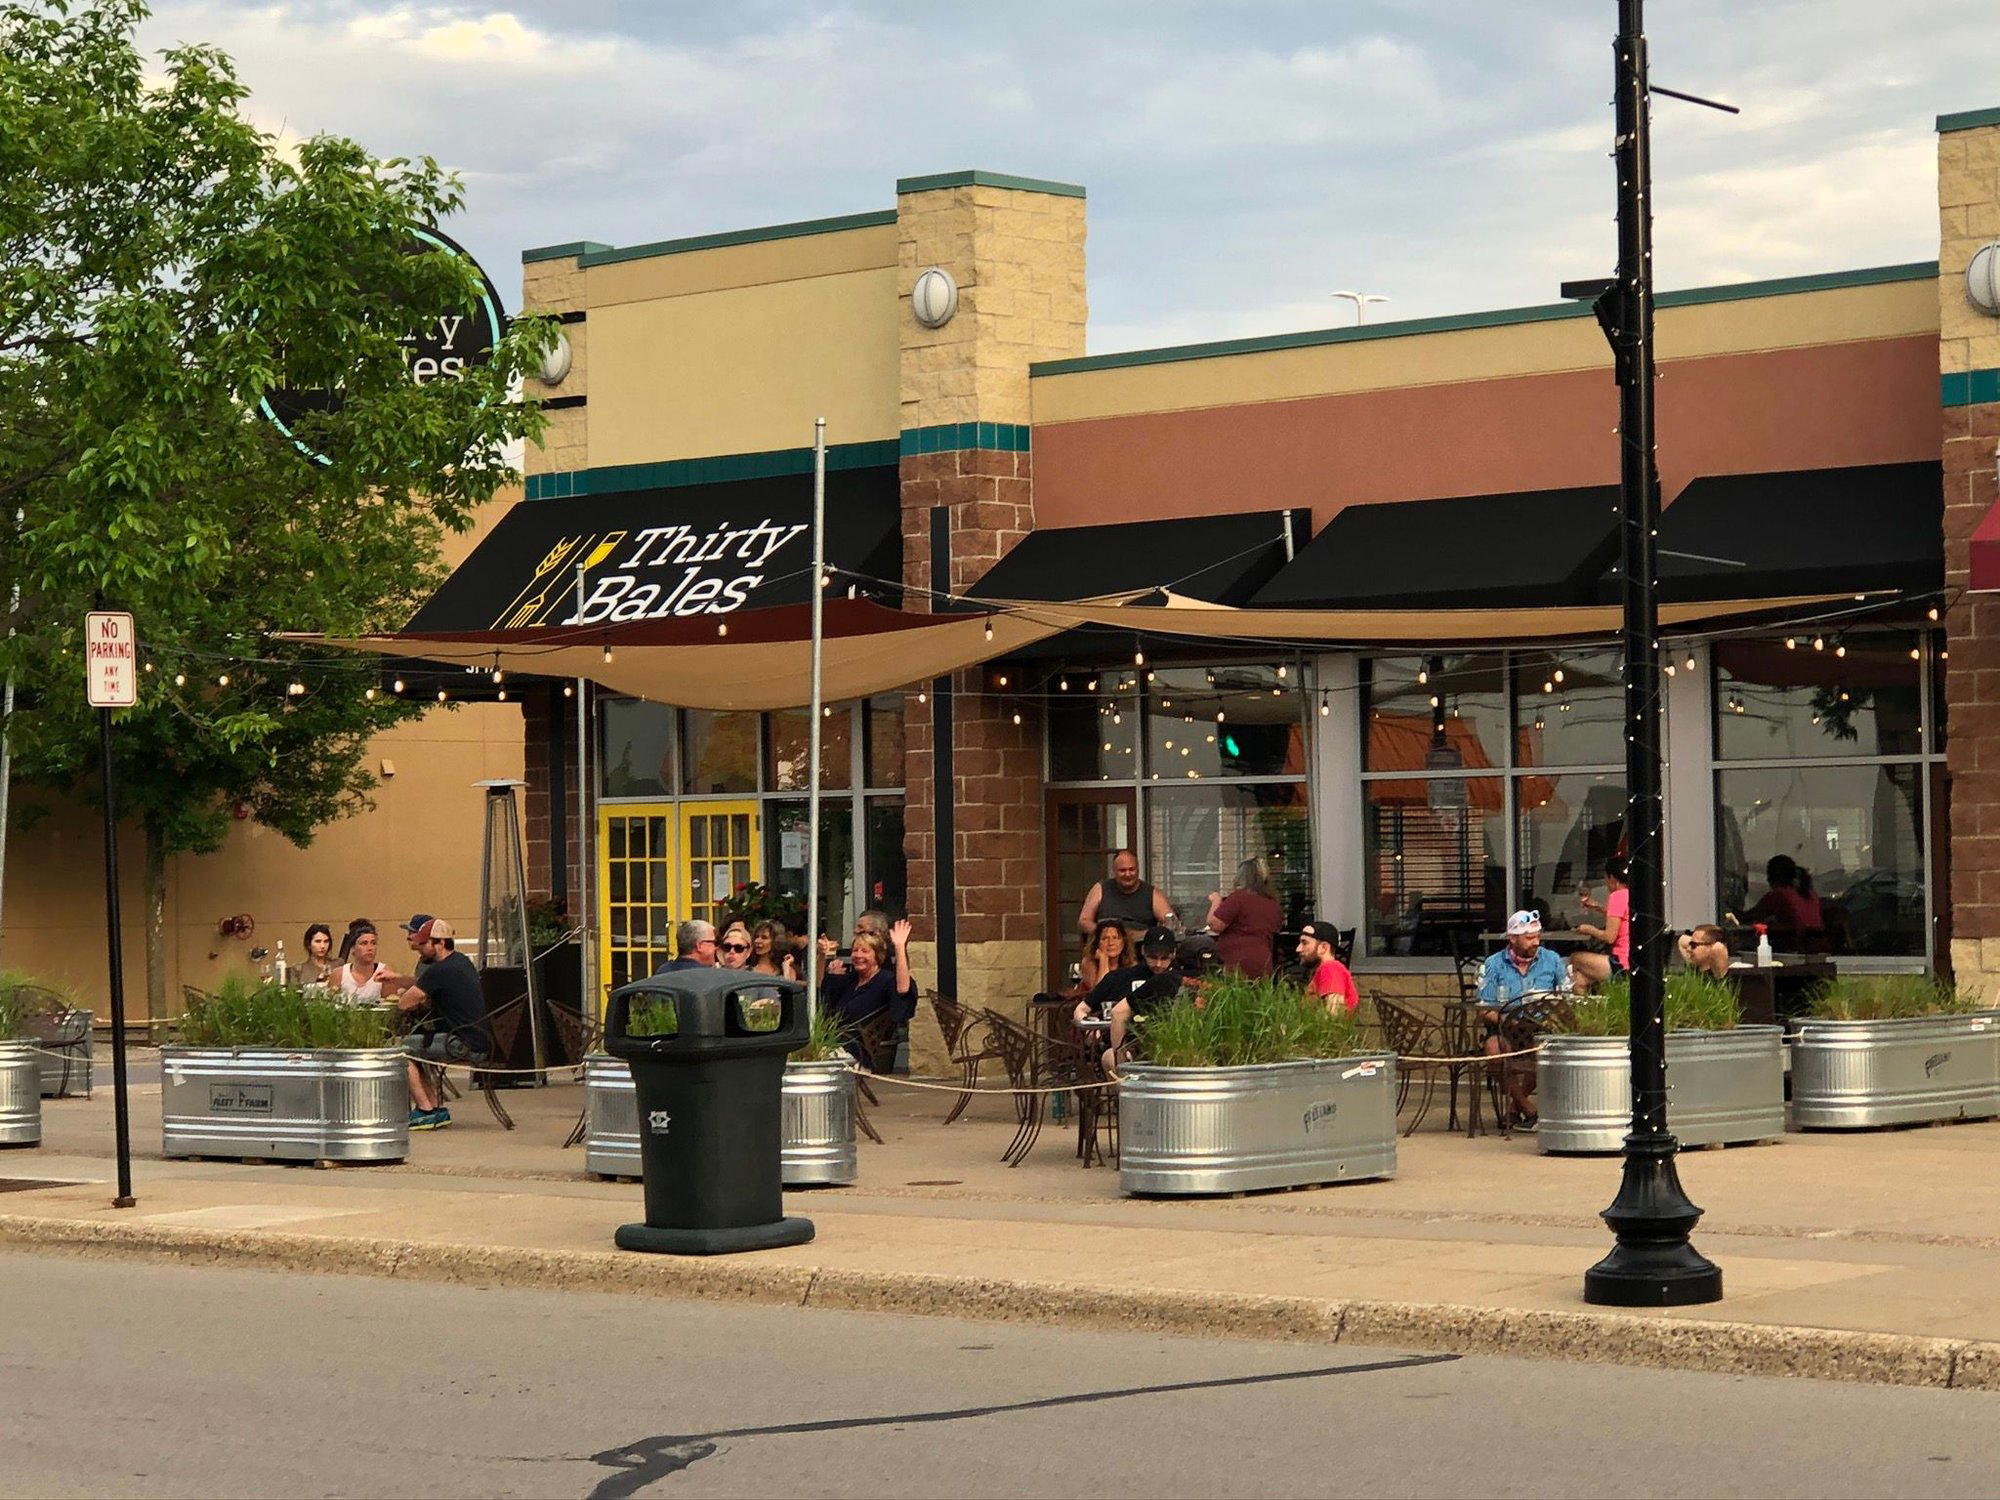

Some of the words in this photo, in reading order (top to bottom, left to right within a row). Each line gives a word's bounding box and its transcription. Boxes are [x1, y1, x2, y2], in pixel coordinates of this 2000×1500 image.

[618, 518, 809, 568] Thirty
[560, 566, 765, 626] Bales
[101, 622, 118, 638] NO
[91, 642, 131, 658] PARKING
[104, 666, 119, 676] ANY
[103, 681, 120, 692] TIME
